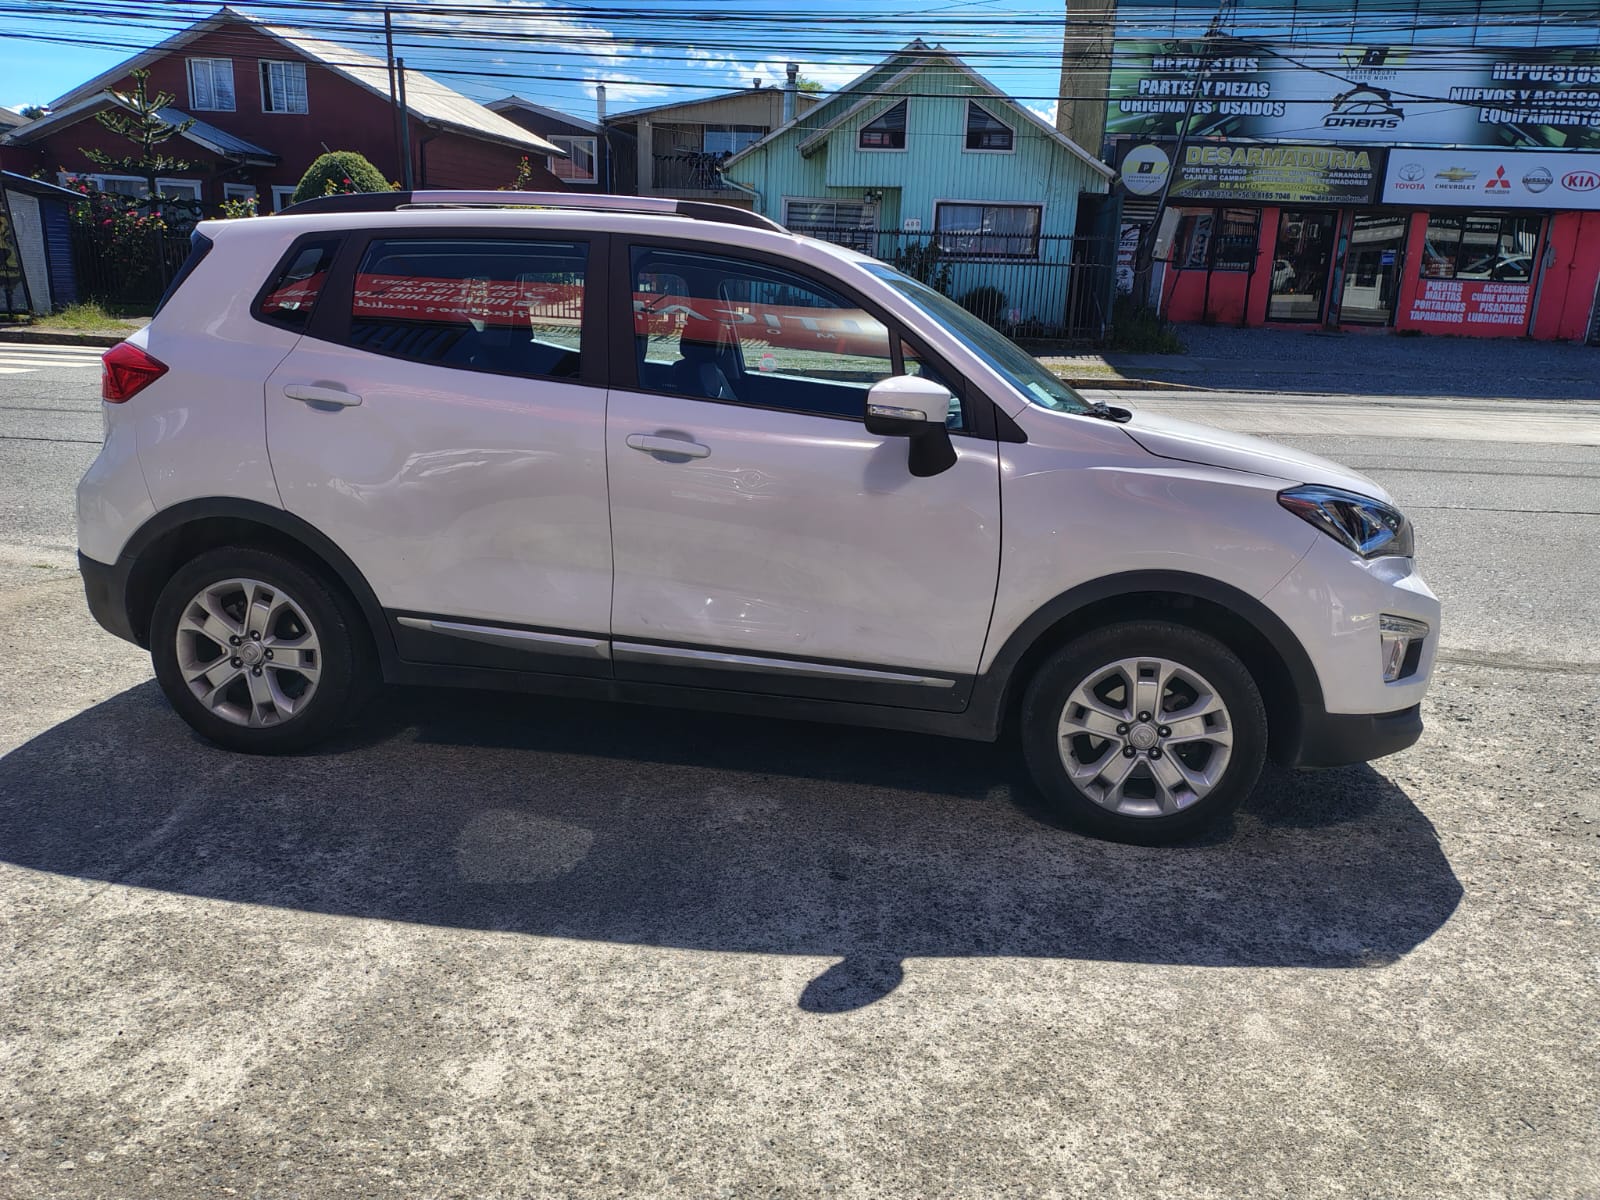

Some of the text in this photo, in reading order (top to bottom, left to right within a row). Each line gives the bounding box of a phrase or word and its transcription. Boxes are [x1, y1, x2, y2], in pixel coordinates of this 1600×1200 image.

[1152, 57, 1259, 72] REPUSTOS
[1492, 62, 1600, 83] REPUESTOS
[1138, 79, 1271, 98] PARTES Y PIEZAS
[1449, 87, 1600, 107] NUEVOS Y ACCESO
[1120, 100, 1285, 116] ORIGINAES USADOS
[1185, 146, 1371, 170] DESARMADURIA
[1219, 181, 1232, 189] DE
[1395, 183, 1426, 191] TOYOTA
[1567, 175, 1595, 187] KIA
[1426, 280, 1464, 292] PUERTAS
[1483, 284, 1530, 294] ACCESORIOS
[1425, 291, 1462, 301] MALETAS
[1472, 292, 1528, 303] CUBRE VOLANTE
[1414, 300, 1467, 312] PORTALONES
[1479, 303, 1527, 314] PISADERAS
[1410, 310, 1464, 323] TAPABARROS
[1467, 312, 1525, 325] LUBRICANTES
